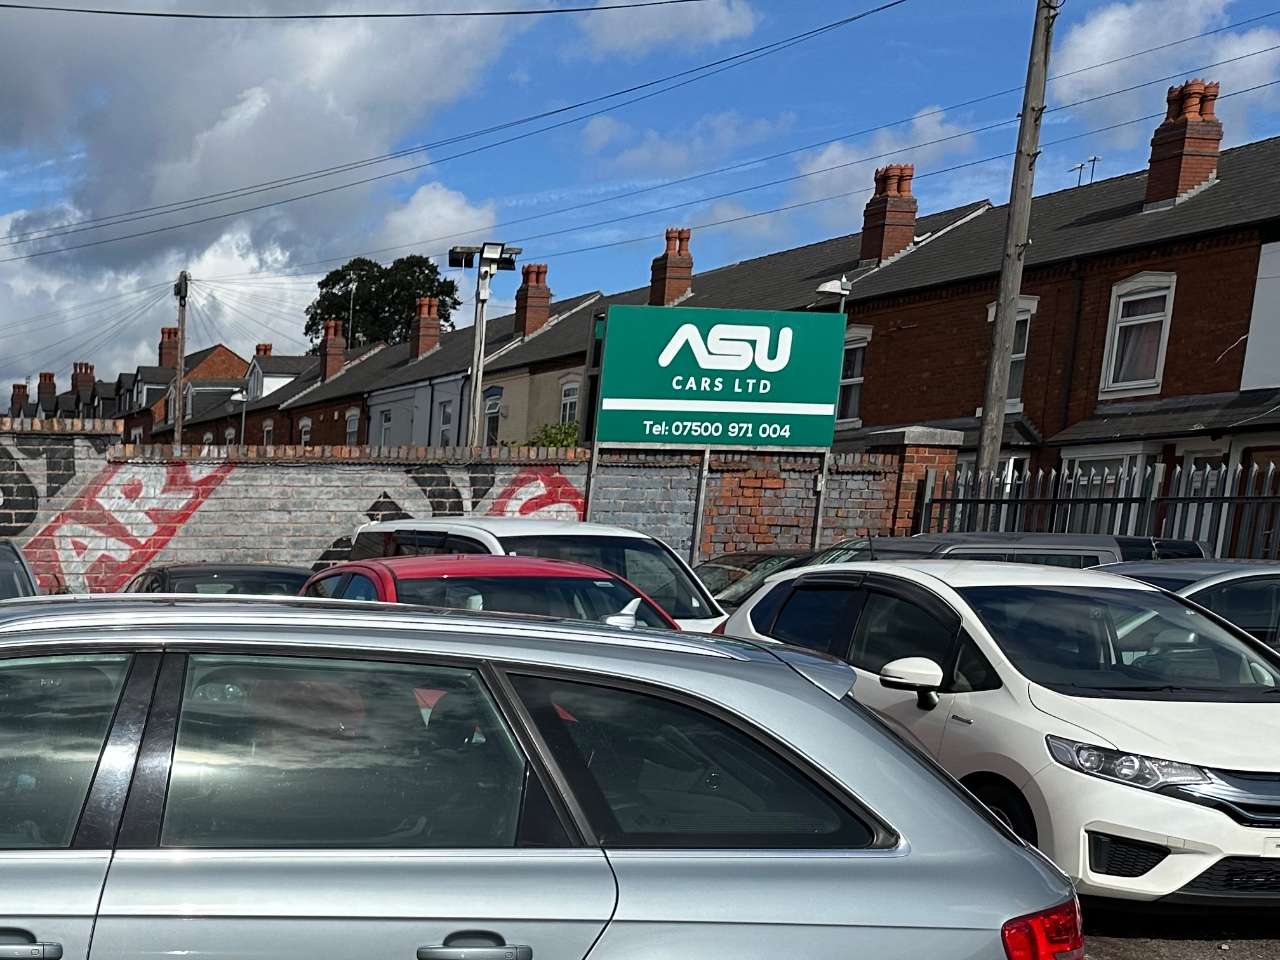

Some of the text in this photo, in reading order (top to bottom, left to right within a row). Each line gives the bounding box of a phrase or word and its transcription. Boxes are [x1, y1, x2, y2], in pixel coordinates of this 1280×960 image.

[657, 323, 793, 373] ASU
[671, 375, 772, 394] CARS LTD
[643, 420, 791, 439] Tel: 07500 971 004
